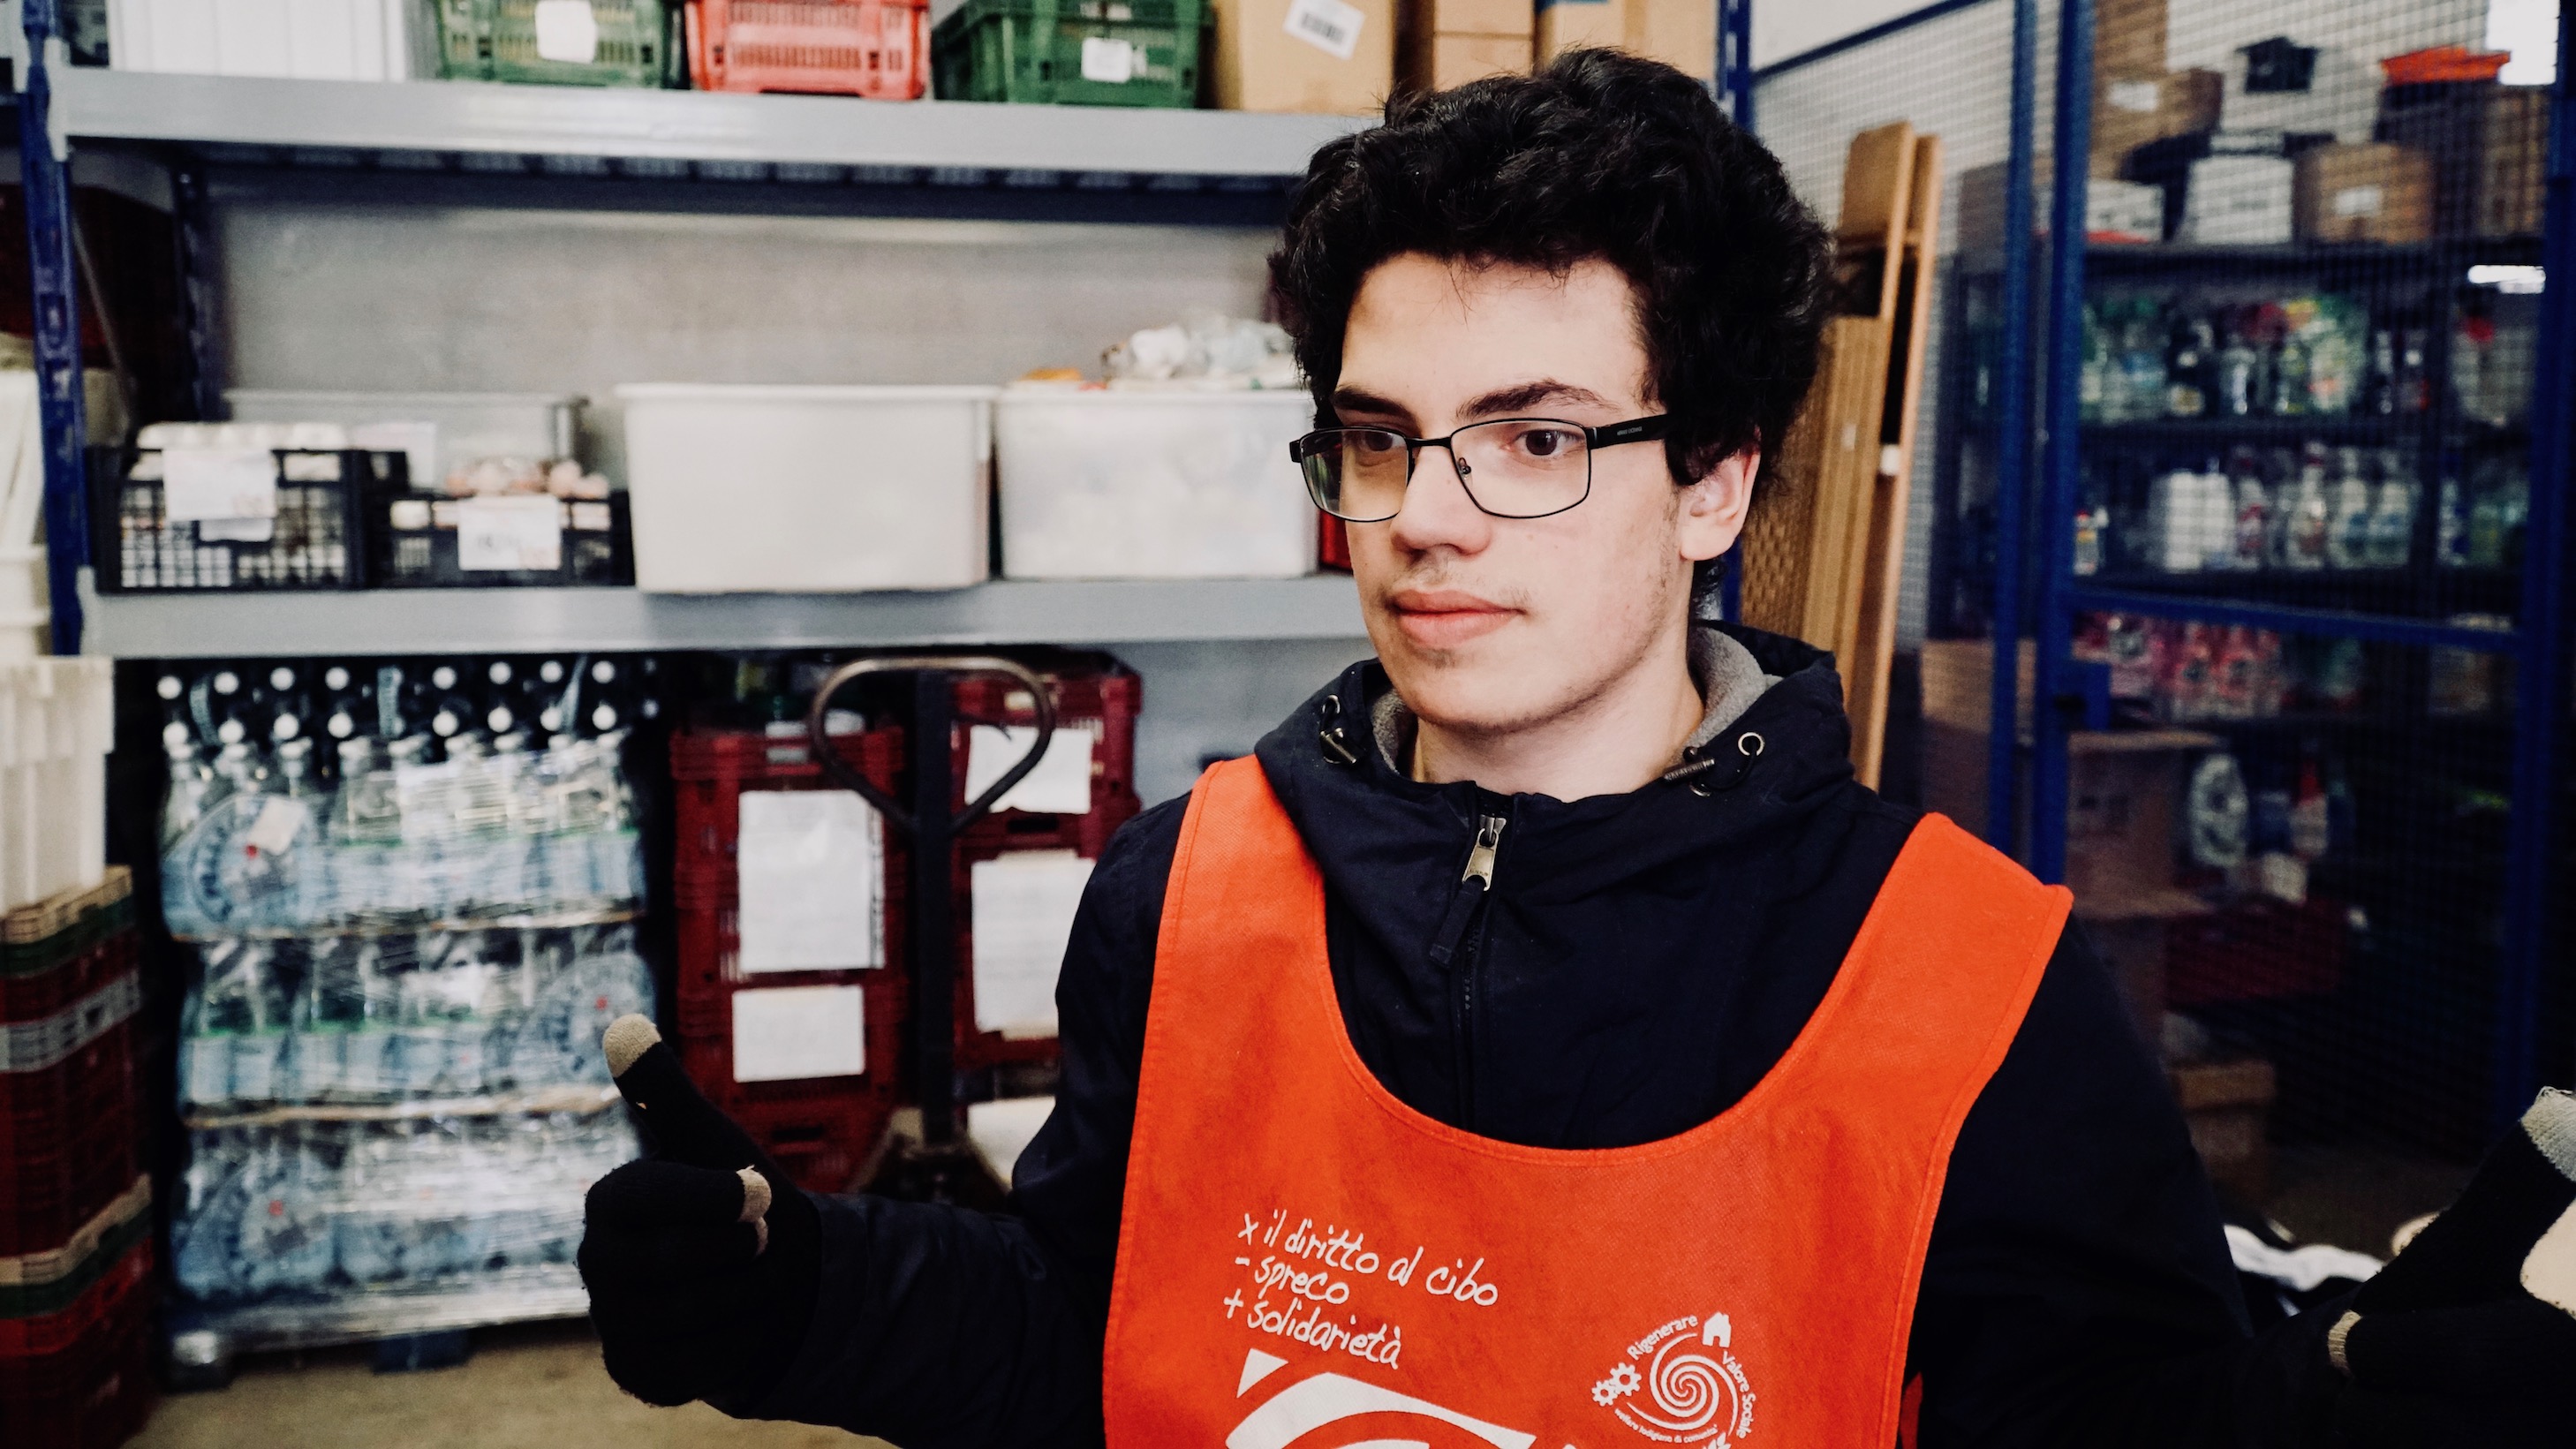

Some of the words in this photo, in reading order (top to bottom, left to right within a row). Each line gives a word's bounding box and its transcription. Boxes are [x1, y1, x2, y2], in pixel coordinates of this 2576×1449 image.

[1254, 1256, 1349, 1305] spreco
[1263, 1209, 1288, 1247] il
[1285, 1219, 1379, 1273] diritto
[1387, 1246, 1424, 1287] al
[1425, 1257, 1498, 1306] cibo
[1223, 1288, 1244, 1319] +
[1247, 1297, 1401, 1370] solidarietà
[1627, 1316, 1698, 1361] Rigenerare
[1722, 1351, 1750, 1392] Valore
[1736, 1393, 1756, 1438] Sociale
